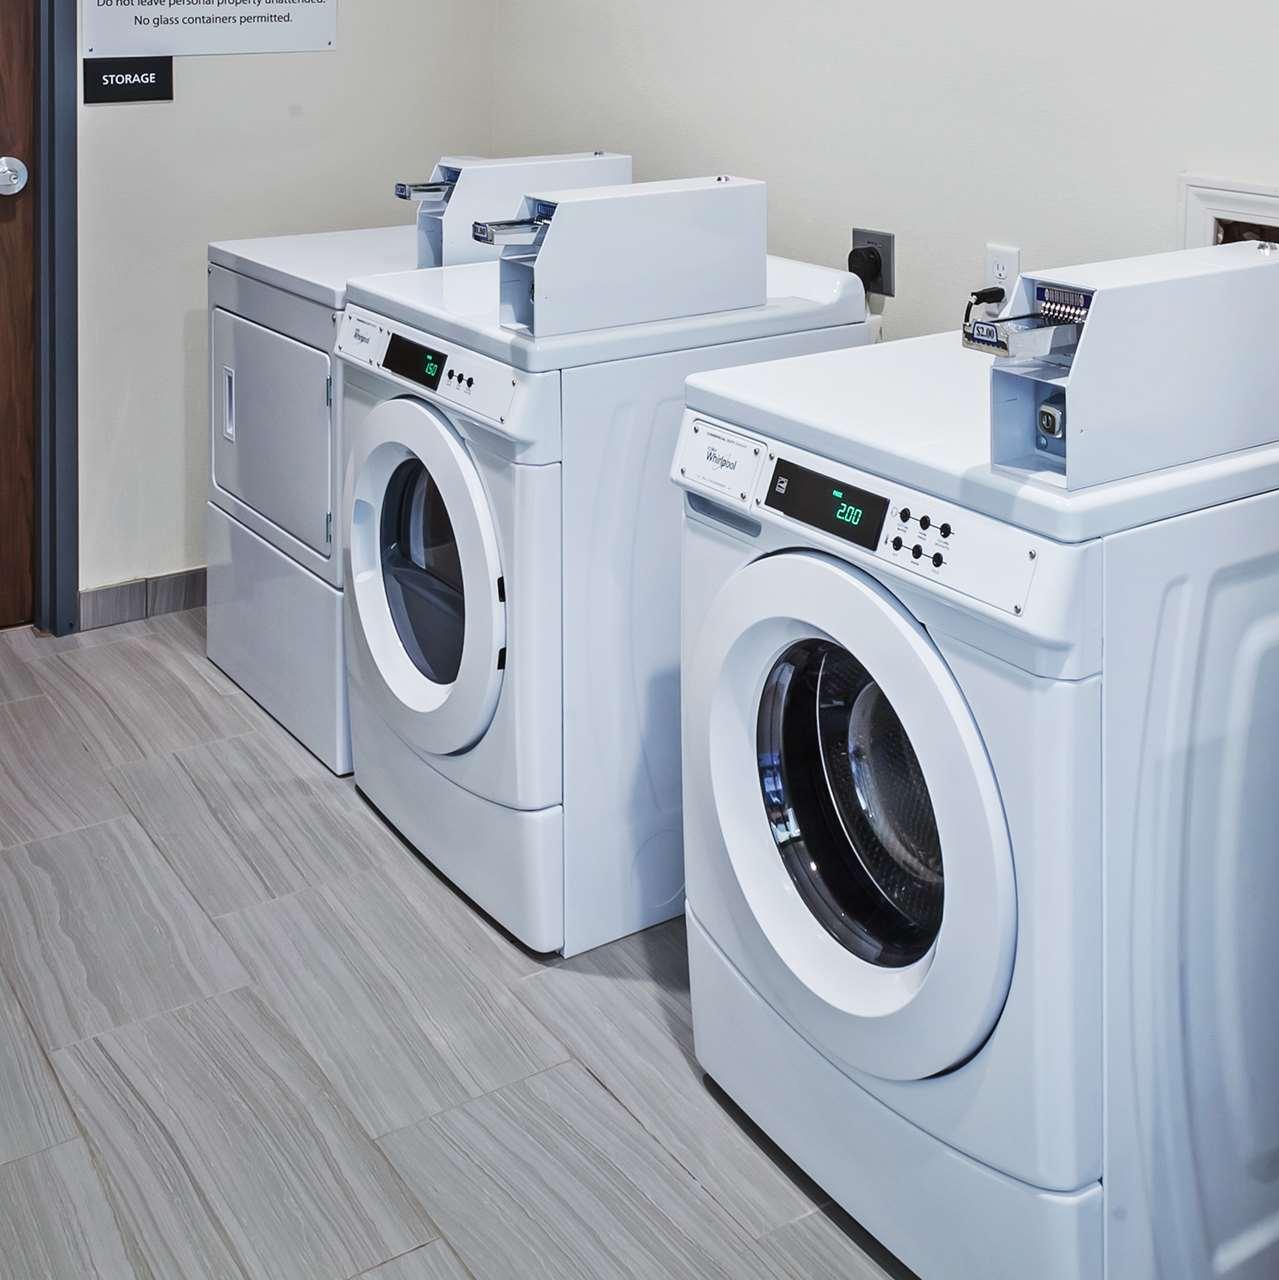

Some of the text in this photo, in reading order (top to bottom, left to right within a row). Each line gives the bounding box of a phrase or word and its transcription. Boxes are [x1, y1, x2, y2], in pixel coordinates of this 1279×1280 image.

[134, 13, 292, 27] No glass containers permitted.
[102, 73, 156, 85] STORAGE
[706, 450, 737, 471] Whirlpool
